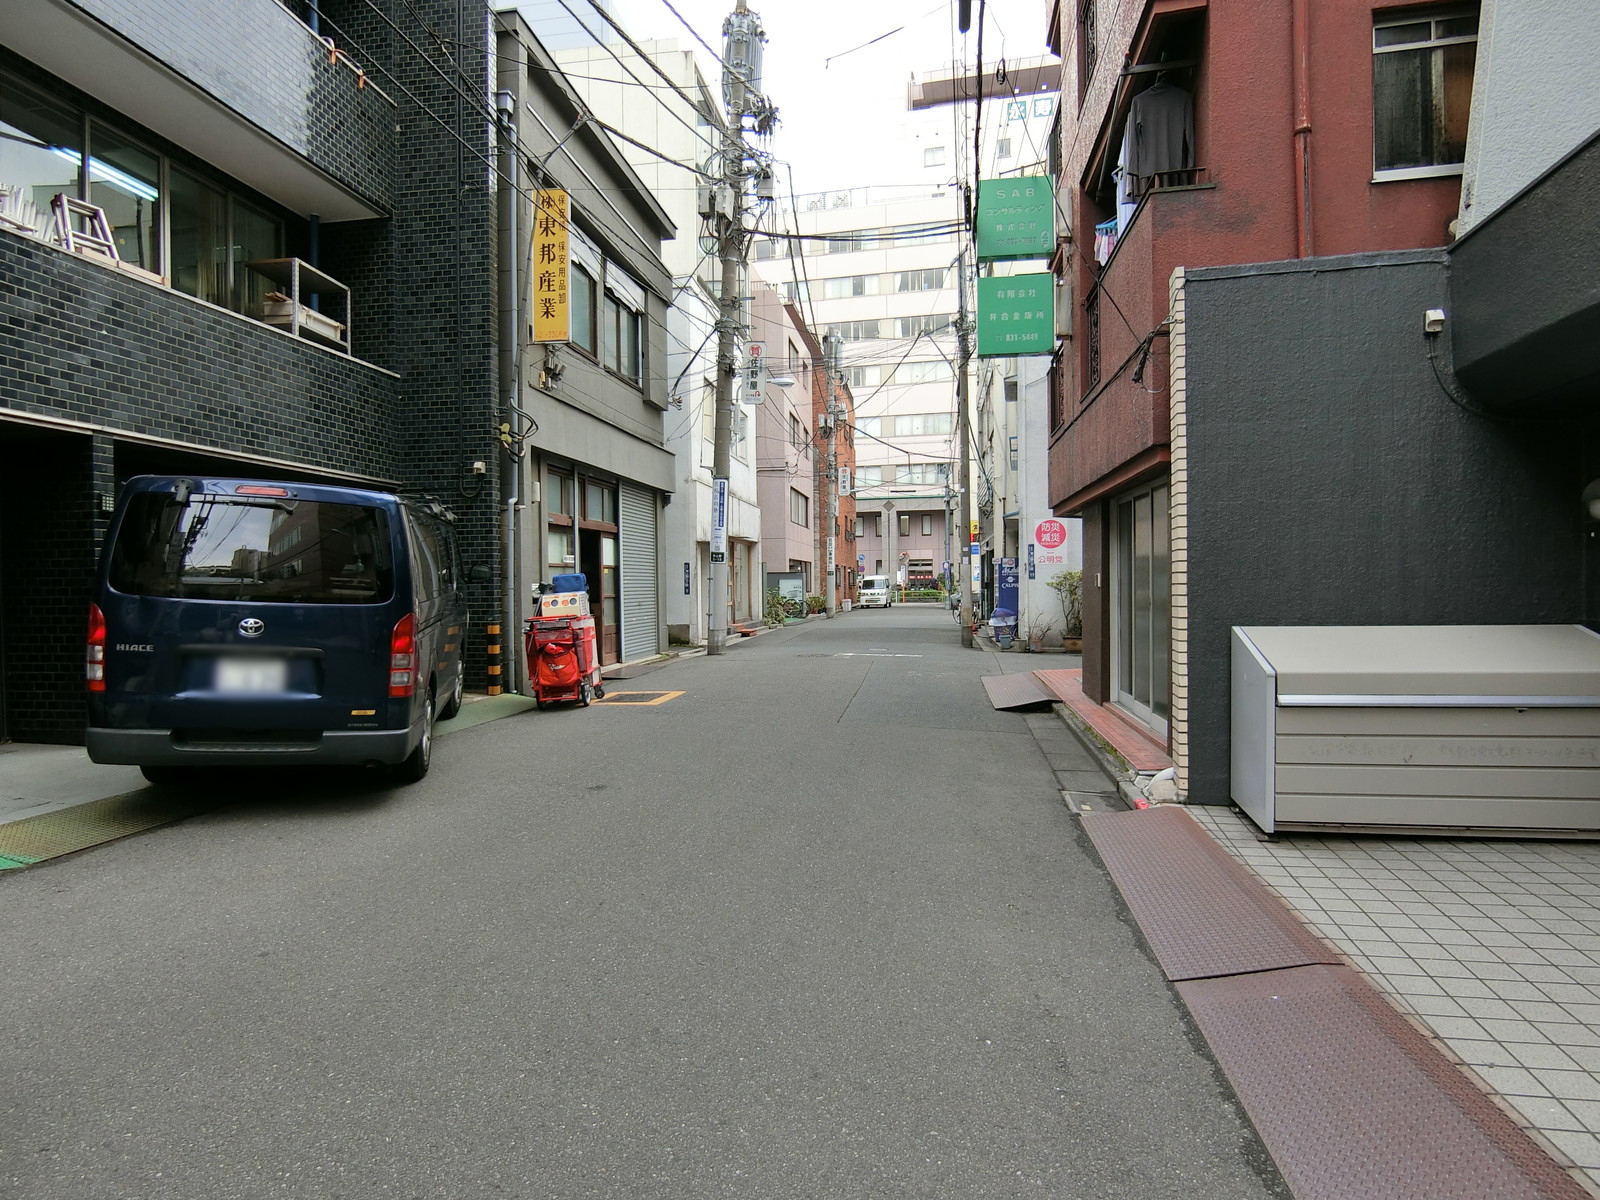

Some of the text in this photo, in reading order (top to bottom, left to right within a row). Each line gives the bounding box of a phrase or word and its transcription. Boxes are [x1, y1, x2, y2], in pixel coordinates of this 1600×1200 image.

[996, 188, 1035, 199] SAB
[986, 202, 1045, 216] コンサルティング
[996, 221, 1036, 232] 株式会社
[997, 288, 1036, 299] 有限会社
[1041, 522, 1060, 532] 防災
[1041, 532, 1060, 543] 減災
[1038, 555, 1063, 564] 公明党
[116, 643, 155, 652] HIACE
